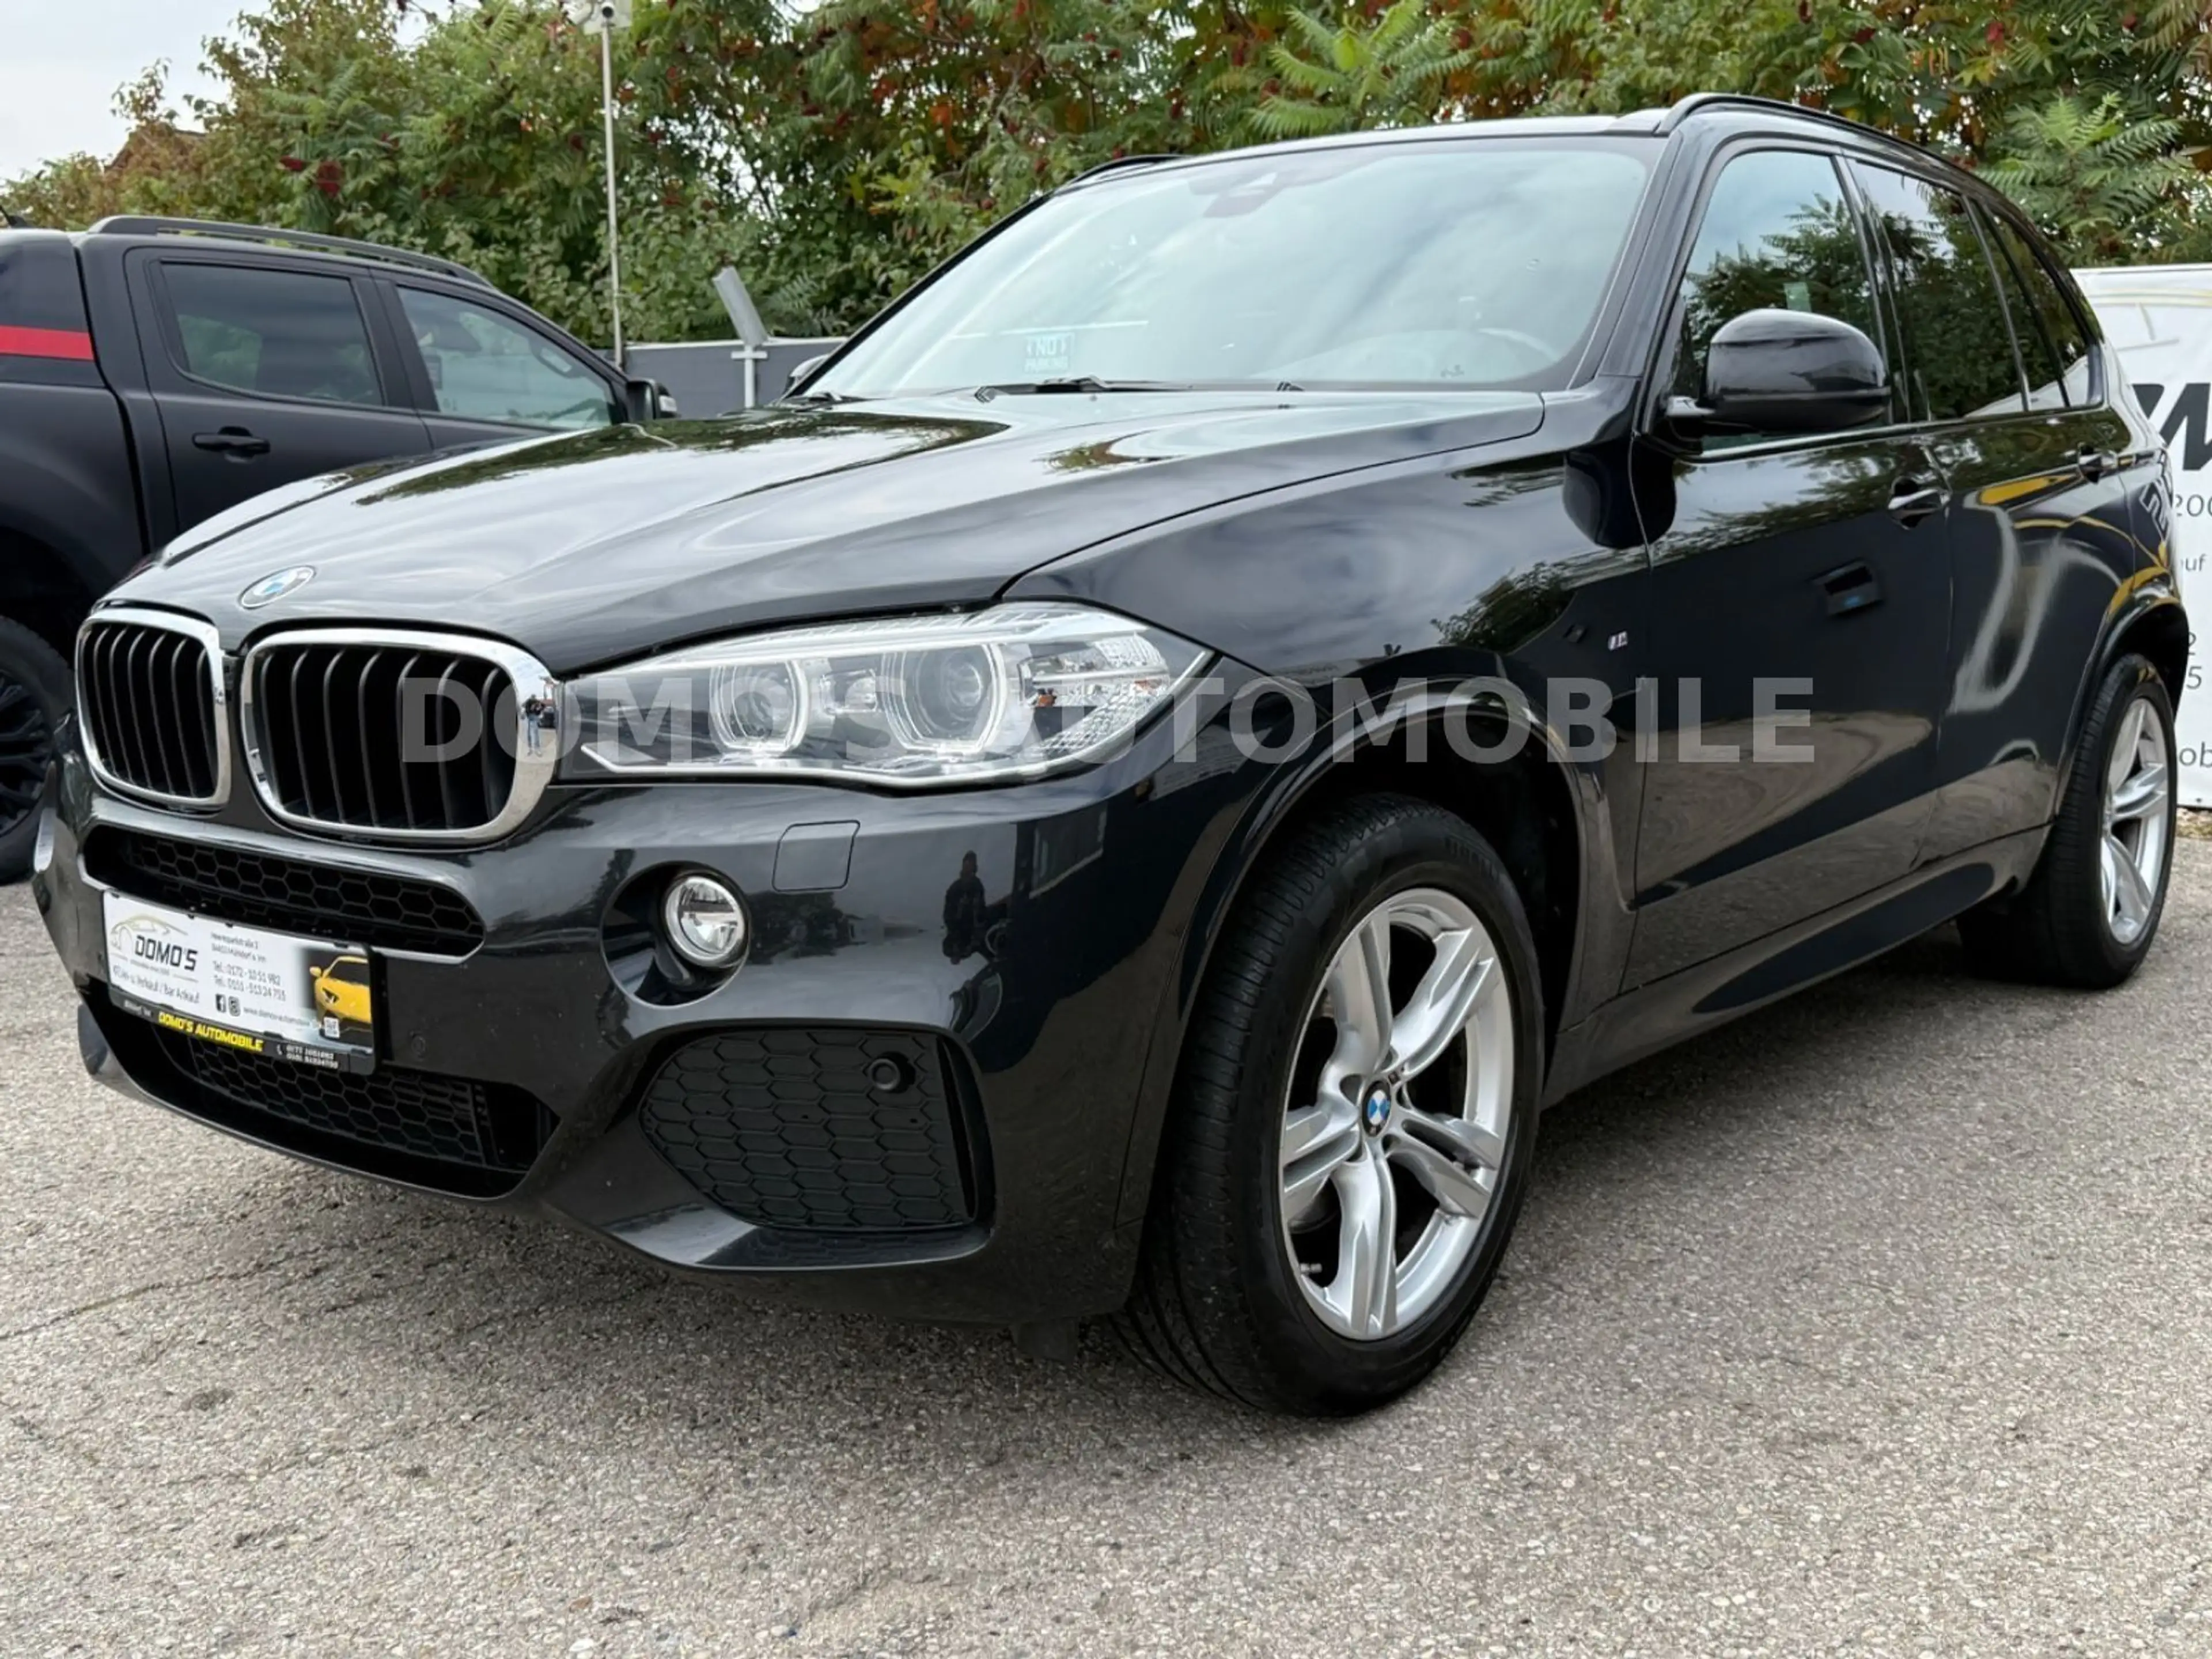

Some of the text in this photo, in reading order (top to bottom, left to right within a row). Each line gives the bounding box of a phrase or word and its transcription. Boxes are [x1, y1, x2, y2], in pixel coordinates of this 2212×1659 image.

[135, 934, 198, 971] DOMO'S
[158, 1011, 194, 1032] DOMO'S
[195, 1023, 264, 1052] AUTOMOBILE
